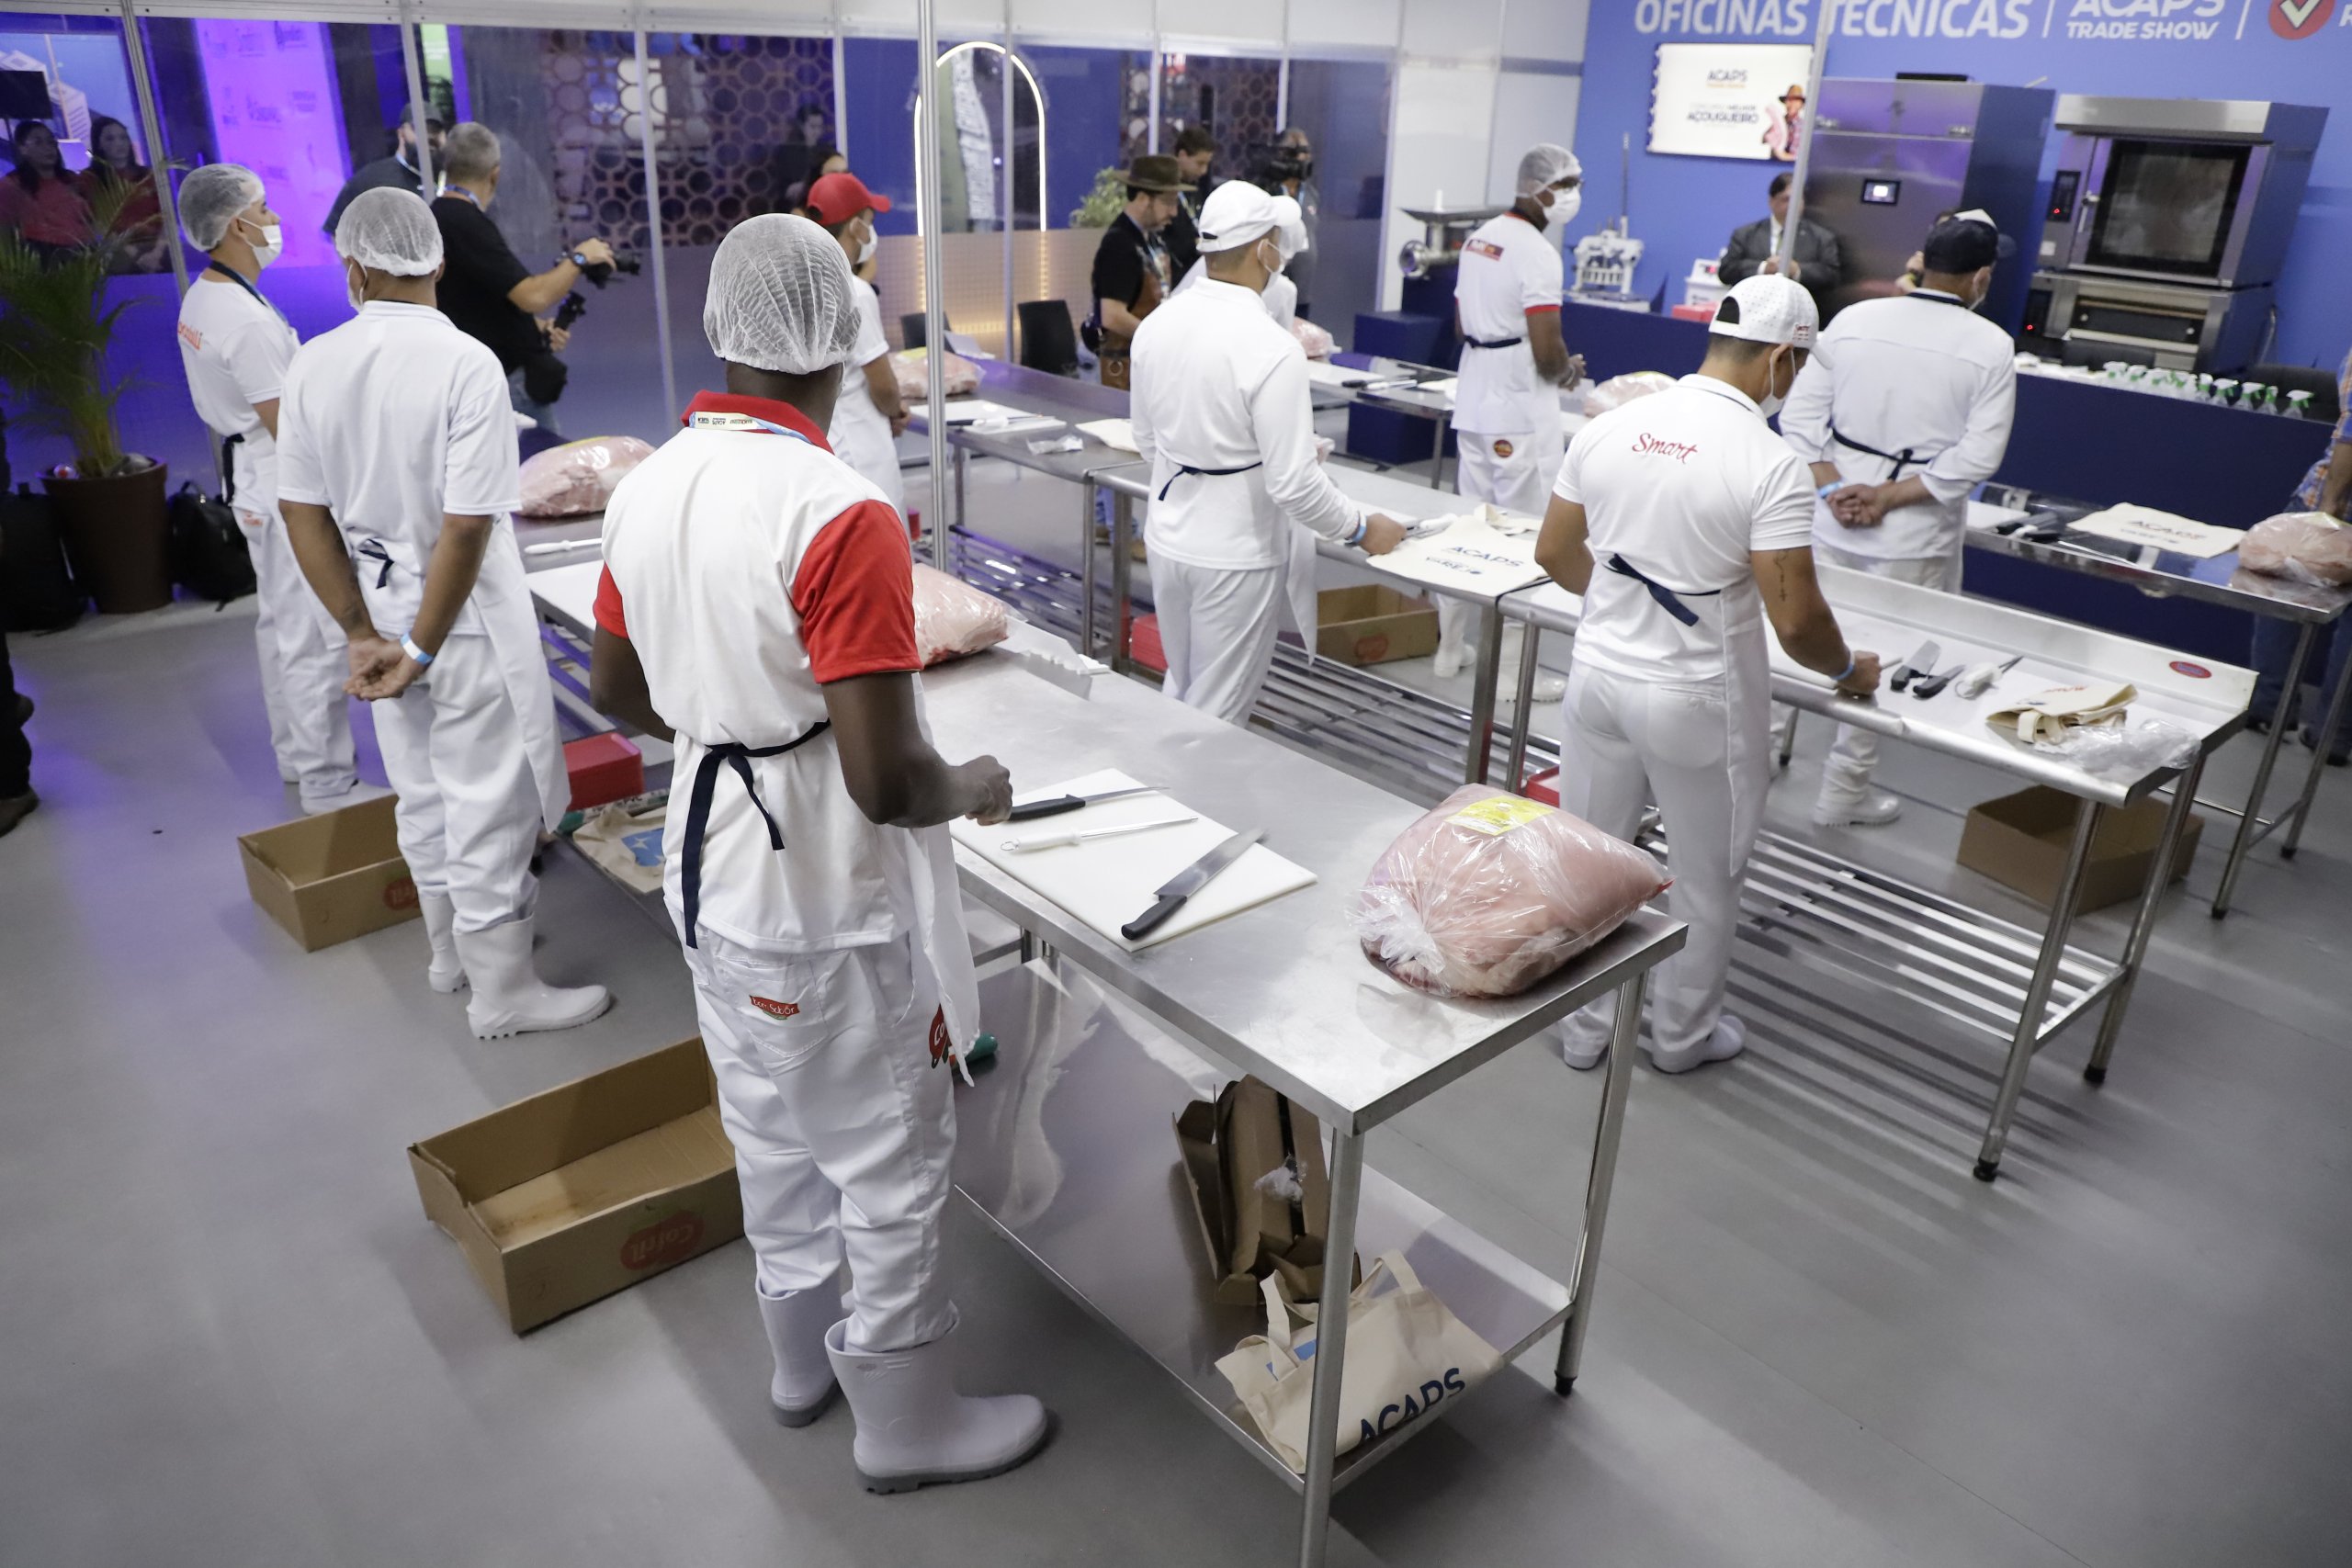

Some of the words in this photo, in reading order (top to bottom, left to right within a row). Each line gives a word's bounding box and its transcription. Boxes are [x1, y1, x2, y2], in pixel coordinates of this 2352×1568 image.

[1634, 0, 1808, 35] OFICINAS
[2066, 21, 2138, 39] TRADE
[2140, 21, 2220, 39] SHOW
[1707, 70, 1747, 82] ACAPS
[1632, 433, 1698, 464] Smart
[1442, 547, 1524, 567] ACAPS
